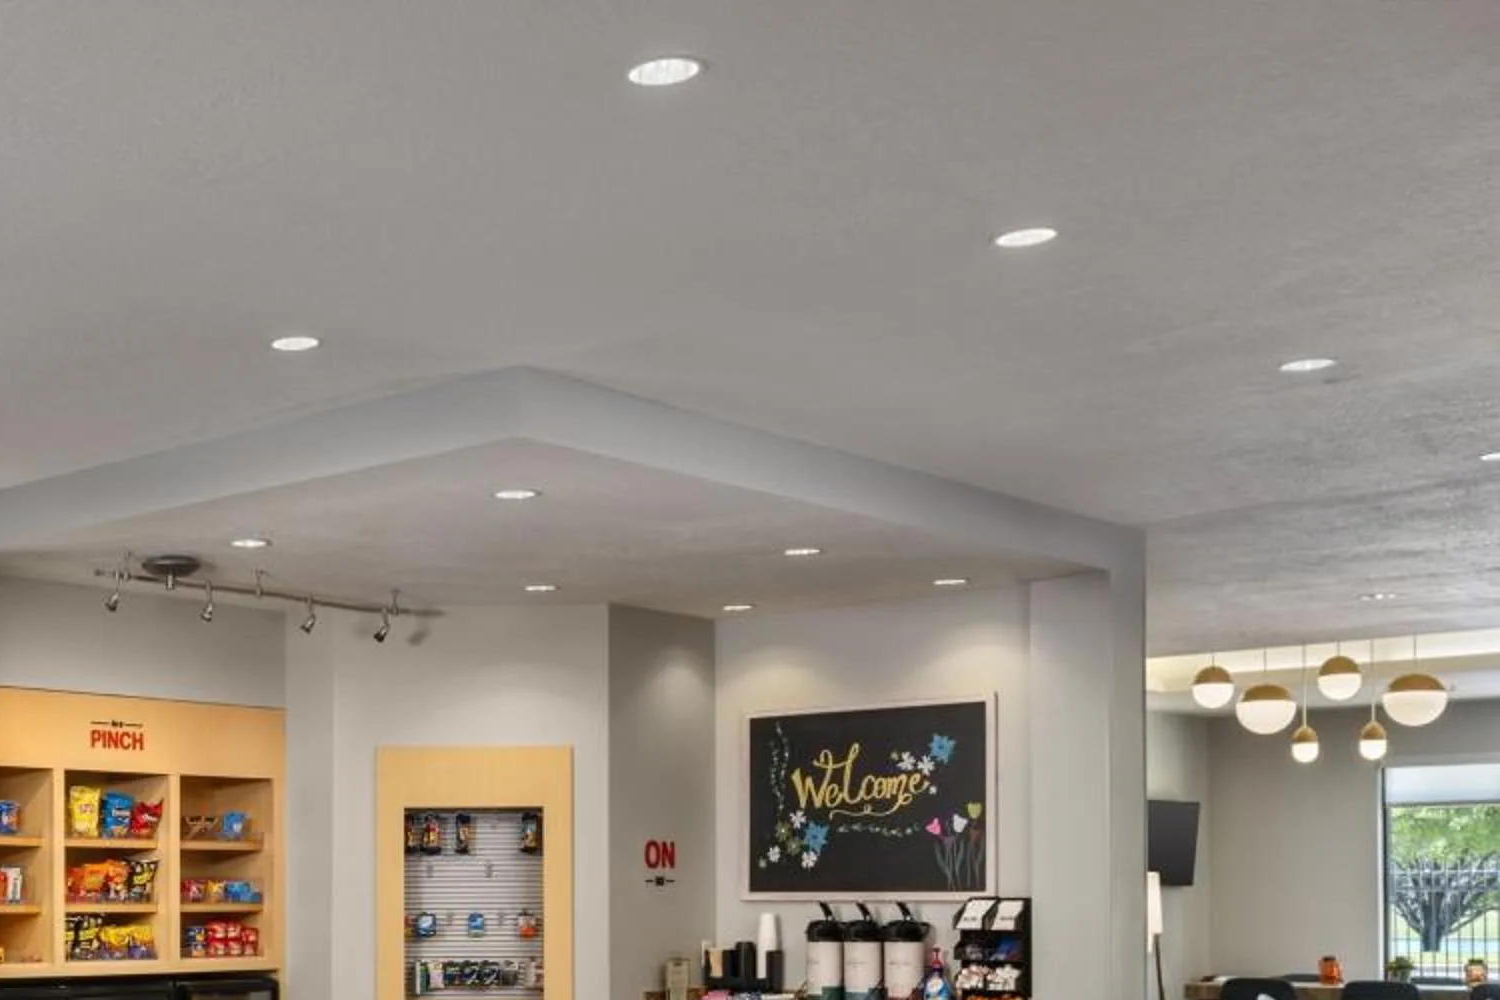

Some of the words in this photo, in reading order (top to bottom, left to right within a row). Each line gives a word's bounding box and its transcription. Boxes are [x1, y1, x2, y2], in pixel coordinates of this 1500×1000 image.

[91, 729, 144, 750] PINCH
[791, 743, 930, 812] Welcome
[644, 840, 675, 869] ON
